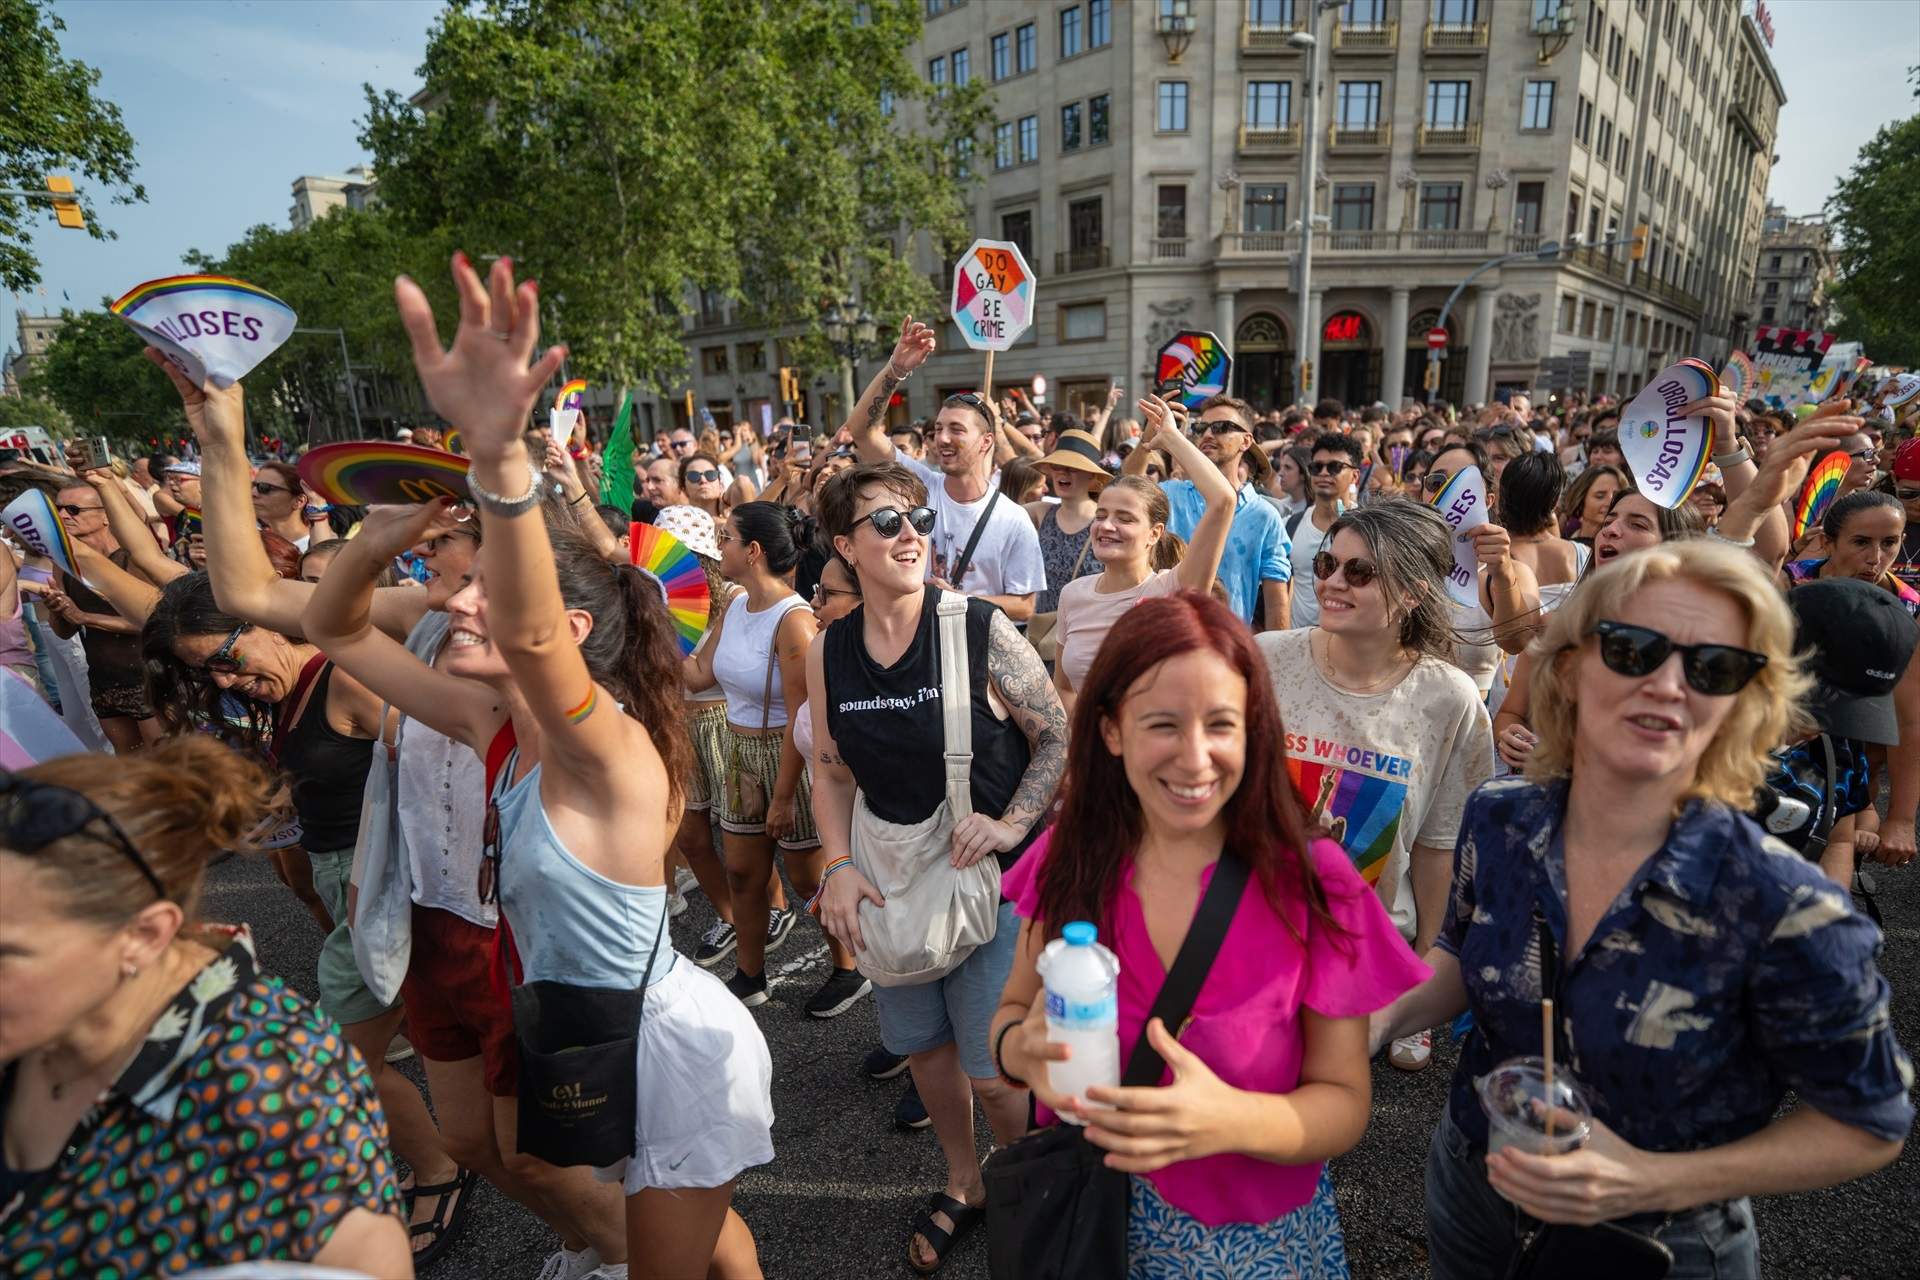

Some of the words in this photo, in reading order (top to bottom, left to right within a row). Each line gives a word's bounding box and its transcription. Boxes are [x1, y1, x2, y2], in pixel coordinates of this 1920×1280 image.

[985, 253, 1007, 272] DO
[976, 273, 1006, 292] GAY
[983, 298, 1002, 318] BE
[973, 319, 1006, 339] CRIME
[1314, 737, 1412, 779] WHOEVER
